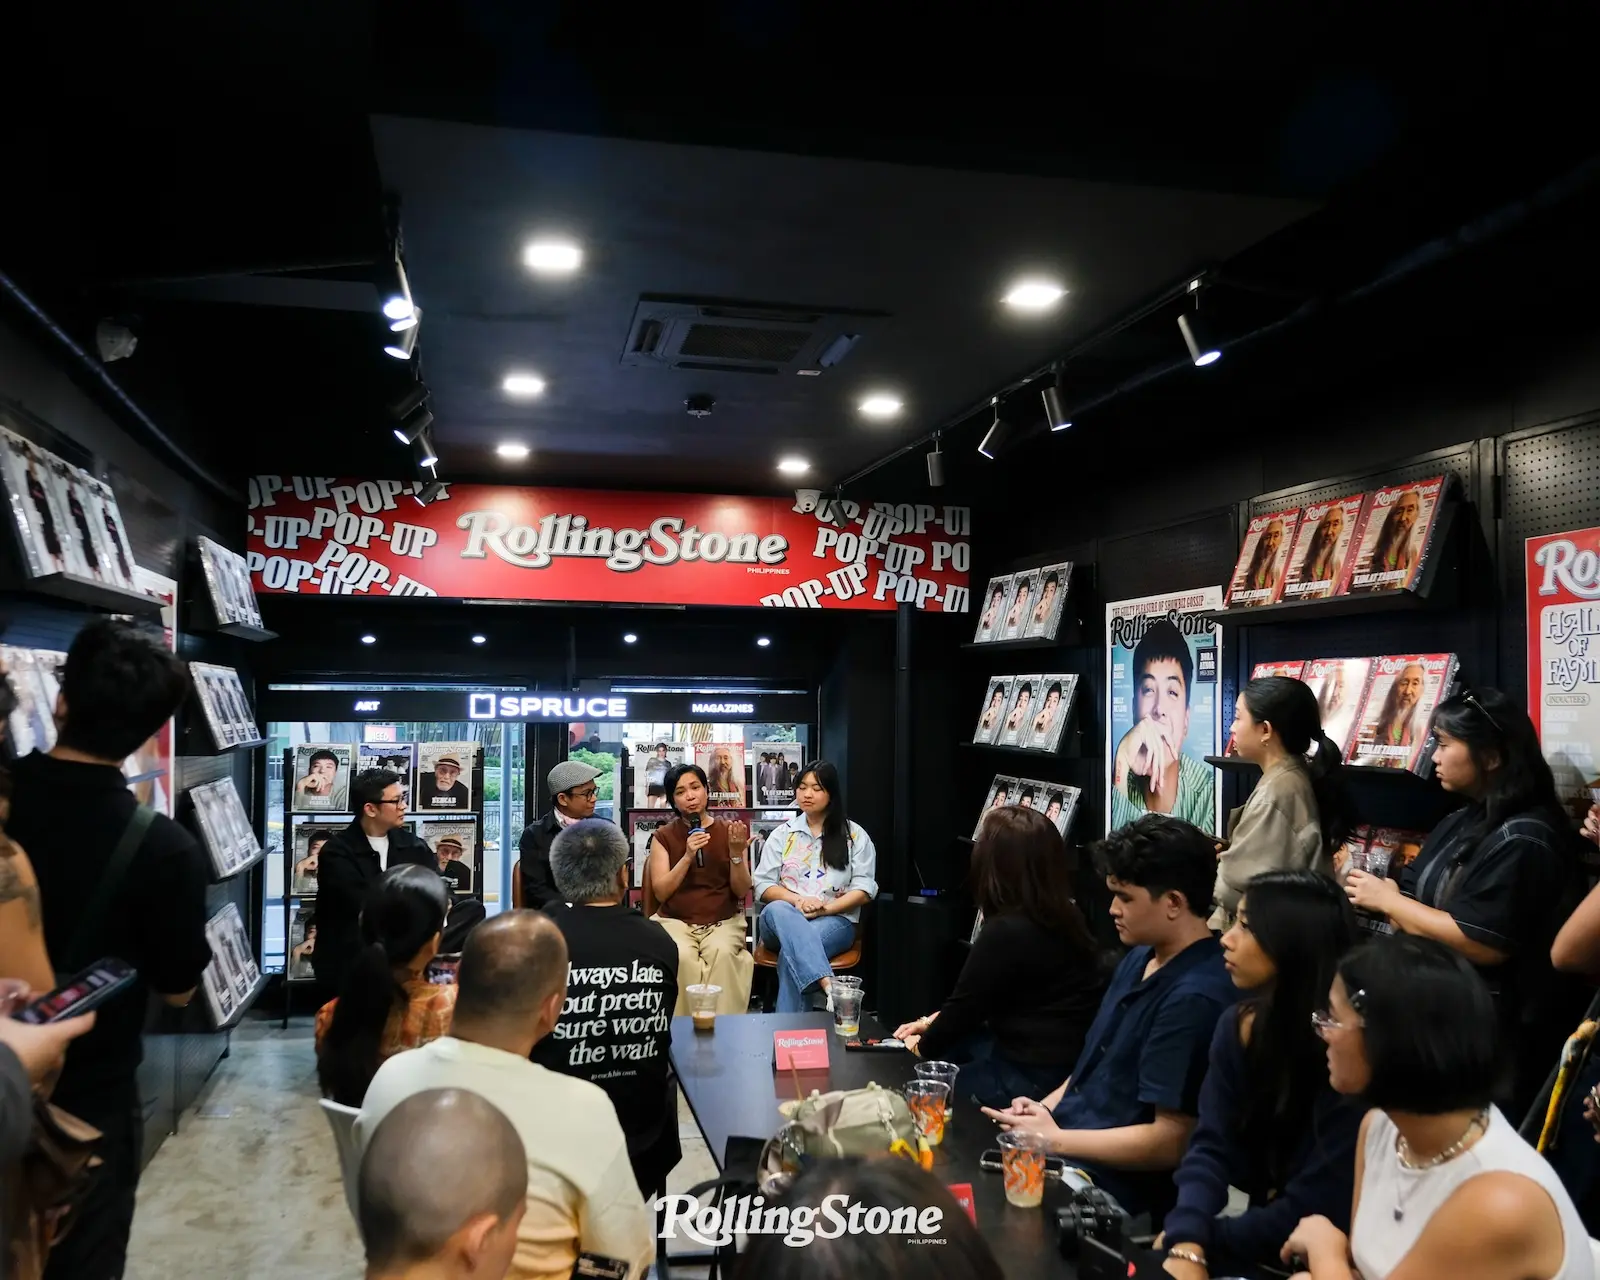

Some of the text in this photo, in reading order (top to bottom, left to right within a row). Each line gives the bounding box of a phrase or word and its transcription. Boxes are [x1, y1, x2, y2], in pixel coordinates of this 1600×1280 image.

[308, 507, 438, 559] POP-UP
[813, 527, 925, 576] POP-UP
[746, 567, 790, 575] PHILIPPINES
[1534, 539, 1600, 599] Ro
[1135, 602, 1158, 615] PLEASURE
[1158, 601, 1165, 612] OF
[1164, 598, 1186, 611] SHOWBIZ
[1186, 595, 1204, 608] GOSSIP
[1545, 608, 1600, 645] HAL
[1568, 637, 1588, 657] OF
[1546, 657, 1600, 692] FAM
[355, 701, 380, 711] ART
[500, 698, 627, 717] SPRUCE
[692, 704, 754, 713] MAGAZINES
[1549, 695, 1586, 704] INDUCTEES
[566, 959, 664, 989] lways late
[598, 988, 664, 1017] pretty
[552, 1008, 668, 1040] sure worth
[568, 1035, 659, 1066] the wait.
